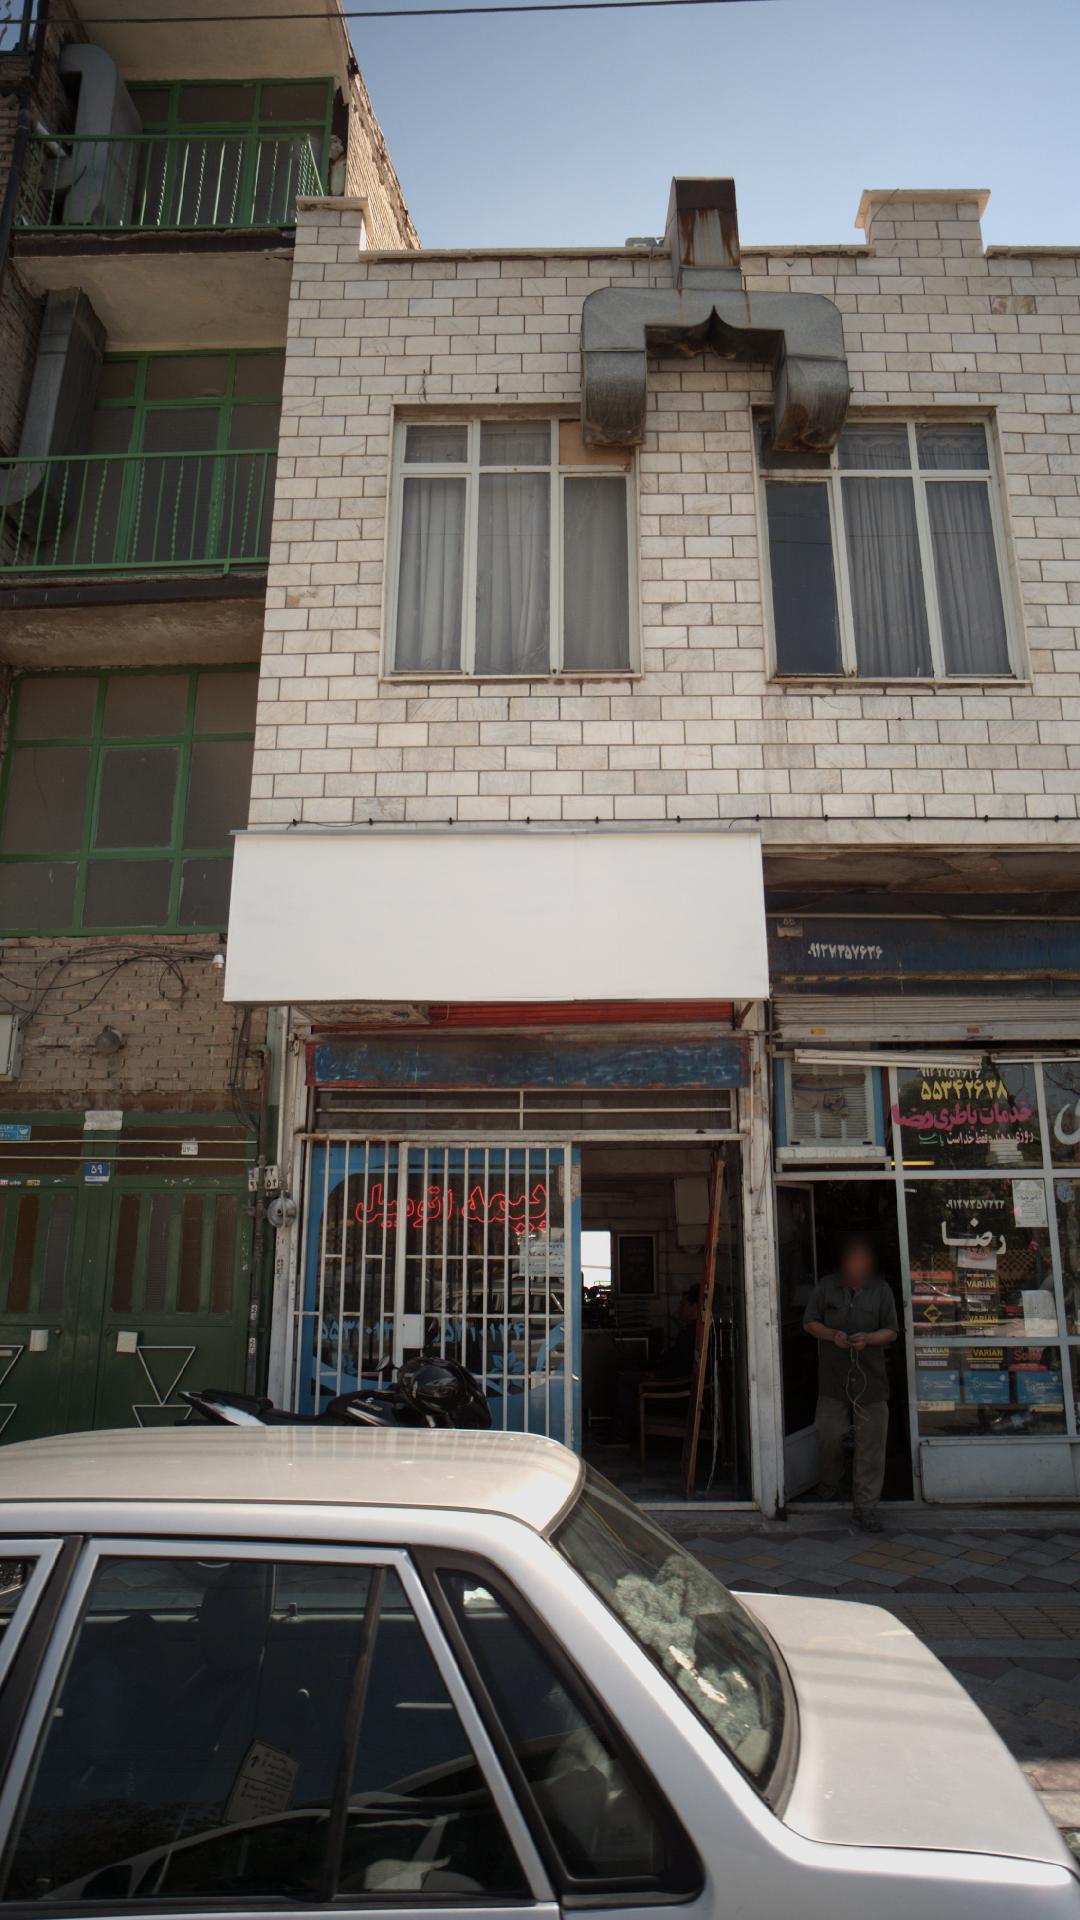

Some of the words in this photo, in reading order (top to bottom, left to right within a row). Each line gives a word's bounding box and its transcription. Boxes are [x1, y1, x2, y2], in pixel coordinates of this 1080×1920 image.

[920, 1079, 1009, 1101] ۵۵۳۴۲۶۳۸
[891, 1104, 935, 1130] رضا
[934, 1102, 978, 1131] باطری
[978, 1101, 1033, 1125] خدمات
[90, 1163, 104, 1175] ۵۹
[355, 1183, 453, 1229] اتومبیل
[940, 1217, 1007, 1255] رضا
[966, 1279, 997, 1289] VARIAN
[968, 1314, 999, 1323] VARIAN
[972, 1348, 1004, 1357] VARIAN
